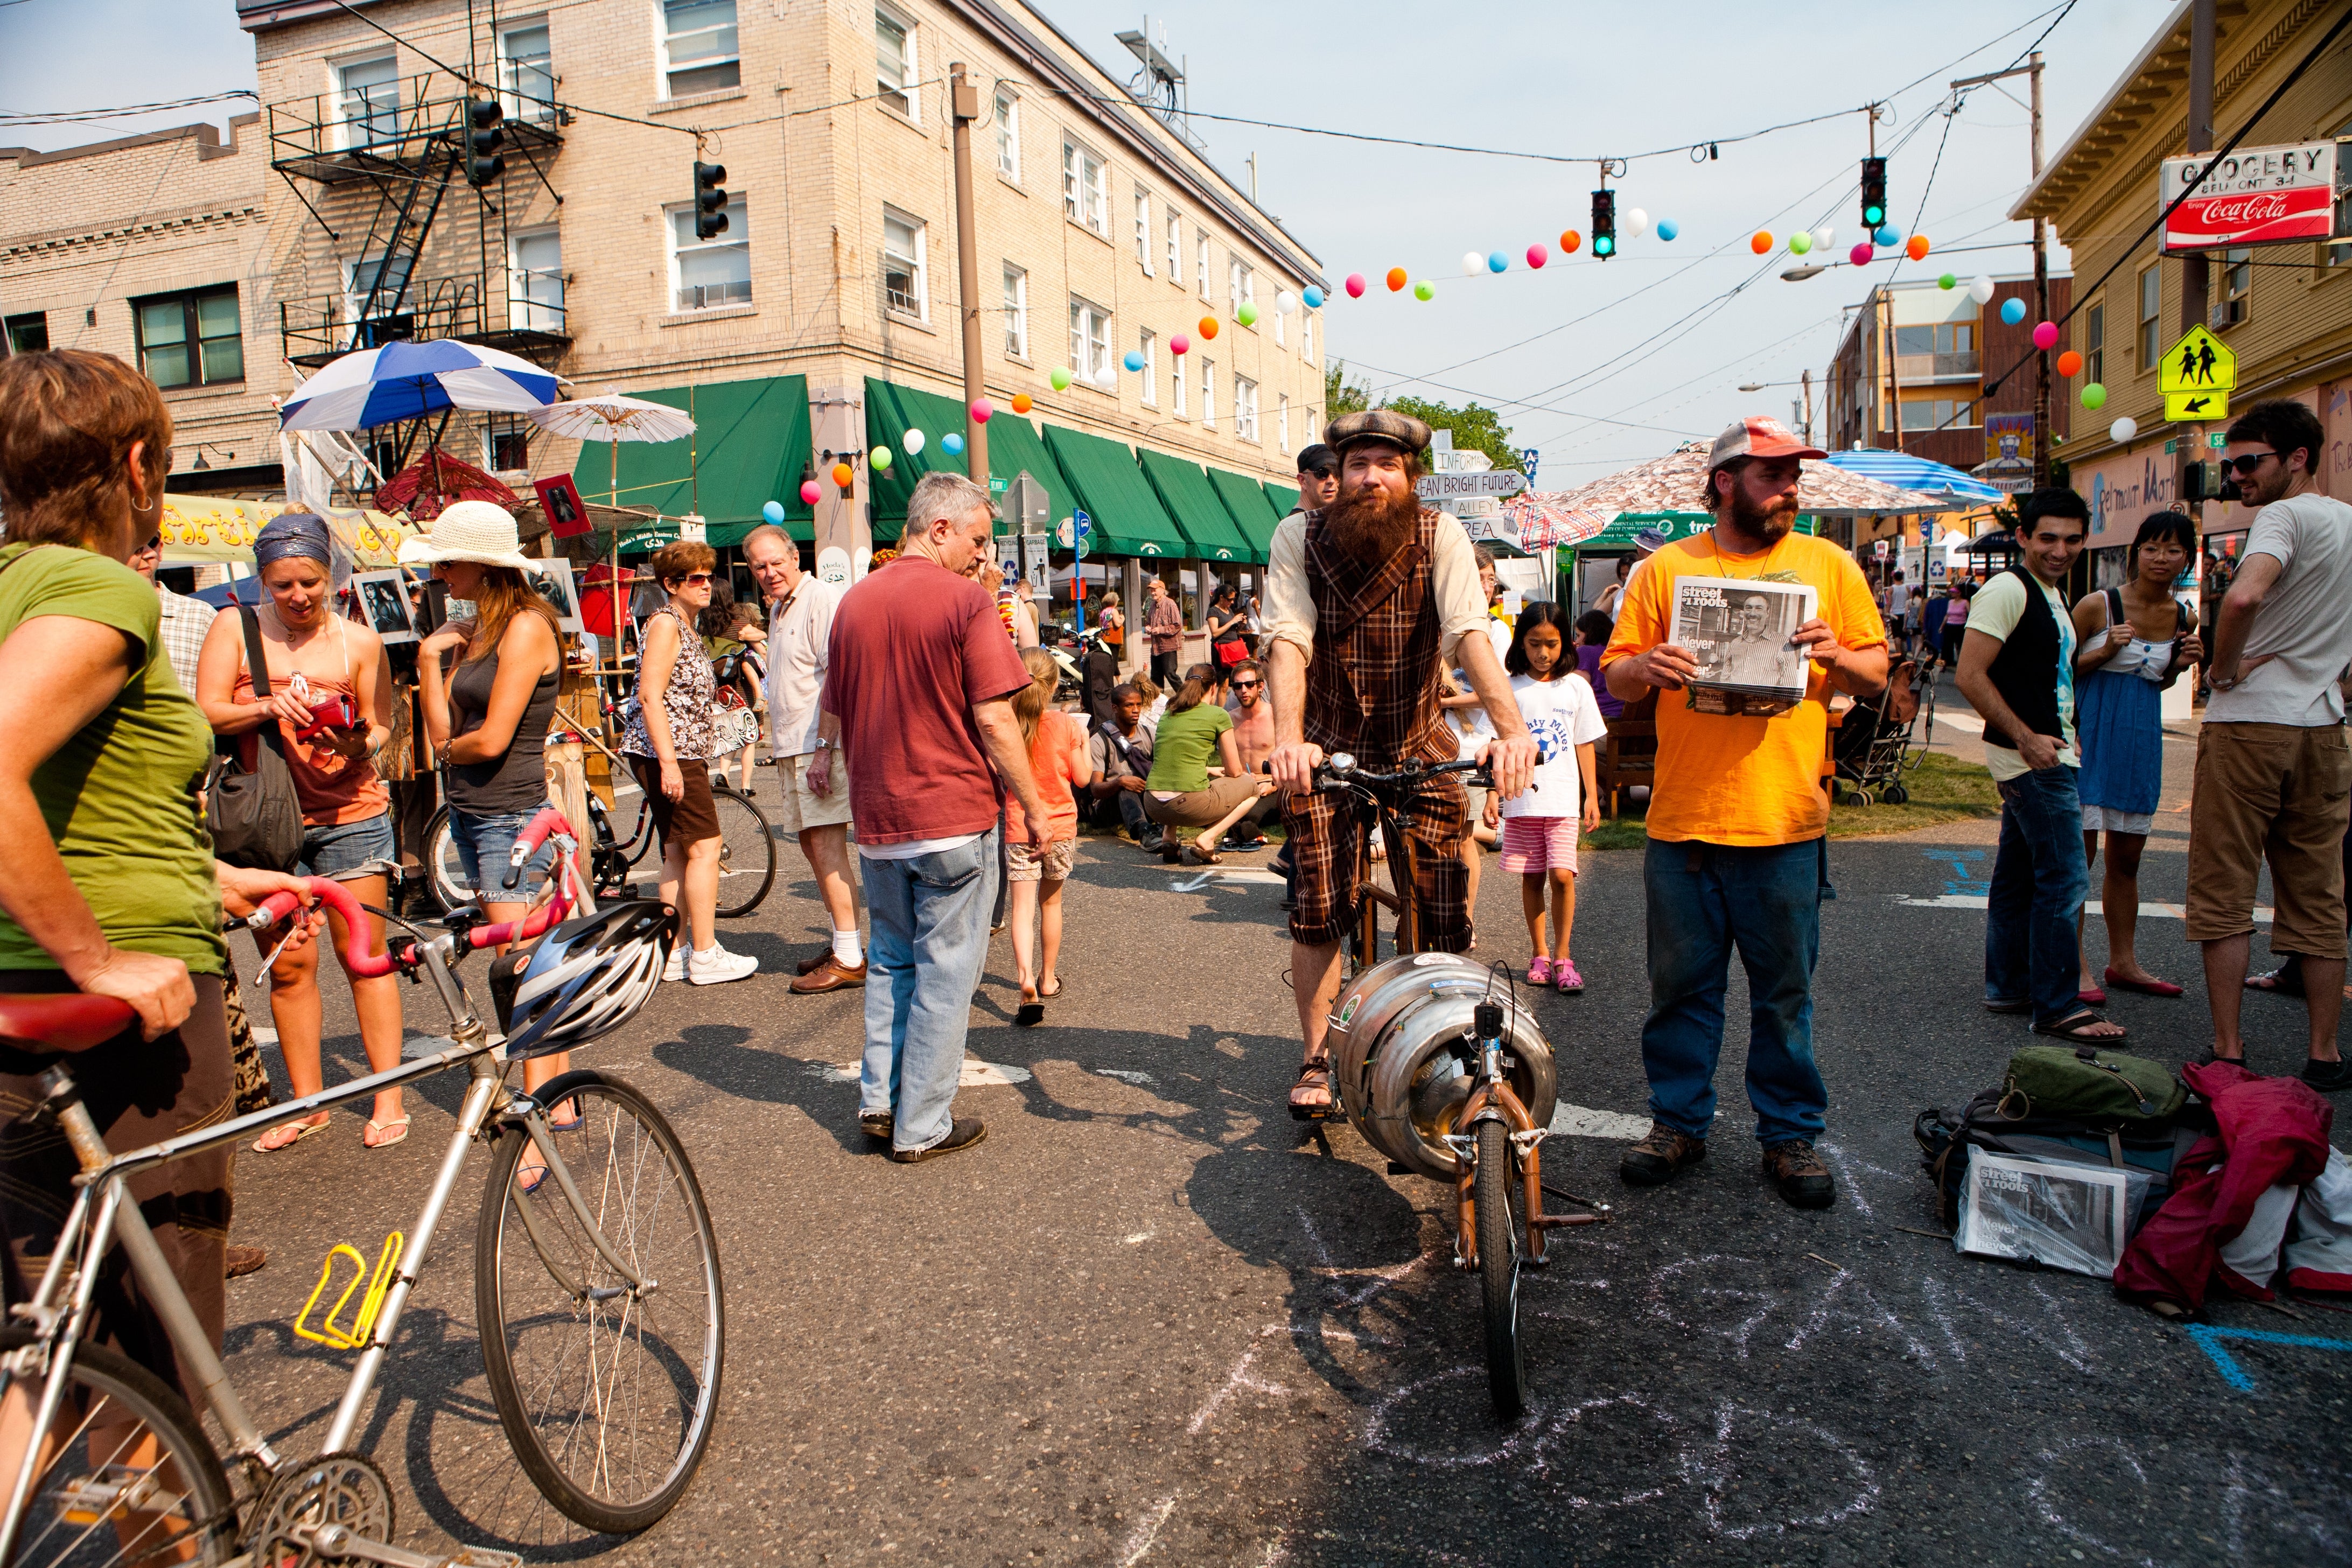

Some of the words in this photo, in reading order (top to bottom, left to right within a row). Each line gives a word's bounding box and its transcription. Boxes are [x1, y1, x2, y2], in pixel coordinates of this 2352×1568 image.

[2181, 149, 2323, 184] GROCERY
[2188, 201, 2206, 209] Enjoy
[2201, 193, 2290, 225] Coca-Cola
[2214, 435, 2225, 446] SE
[1437, 452, 1491, 471] INFORMATION
[1419, 477, 1440, 498] EAN
[1444, 475, 1479, 493] BRIGHT
[1482, 474, 1518, 493] FUTURE
[1457, 499, 1495, 515] ALLEY
[636, 532, 654, 541] Middle
[1461, 521, 1499, 539] REA
[822, 562, 845, 570] Hoda's
[1682, 586, 1723, 599] street
[1692, 597, 1728, 608] roots
[1525, 718, 1545, 730] hty
[1549, 718, 1568, 752] Mites
[516, 957, 529, 971] BELL
[1980, 1166, 2022, 1182] street
[1991, 1179, 2029, 1193] roots
